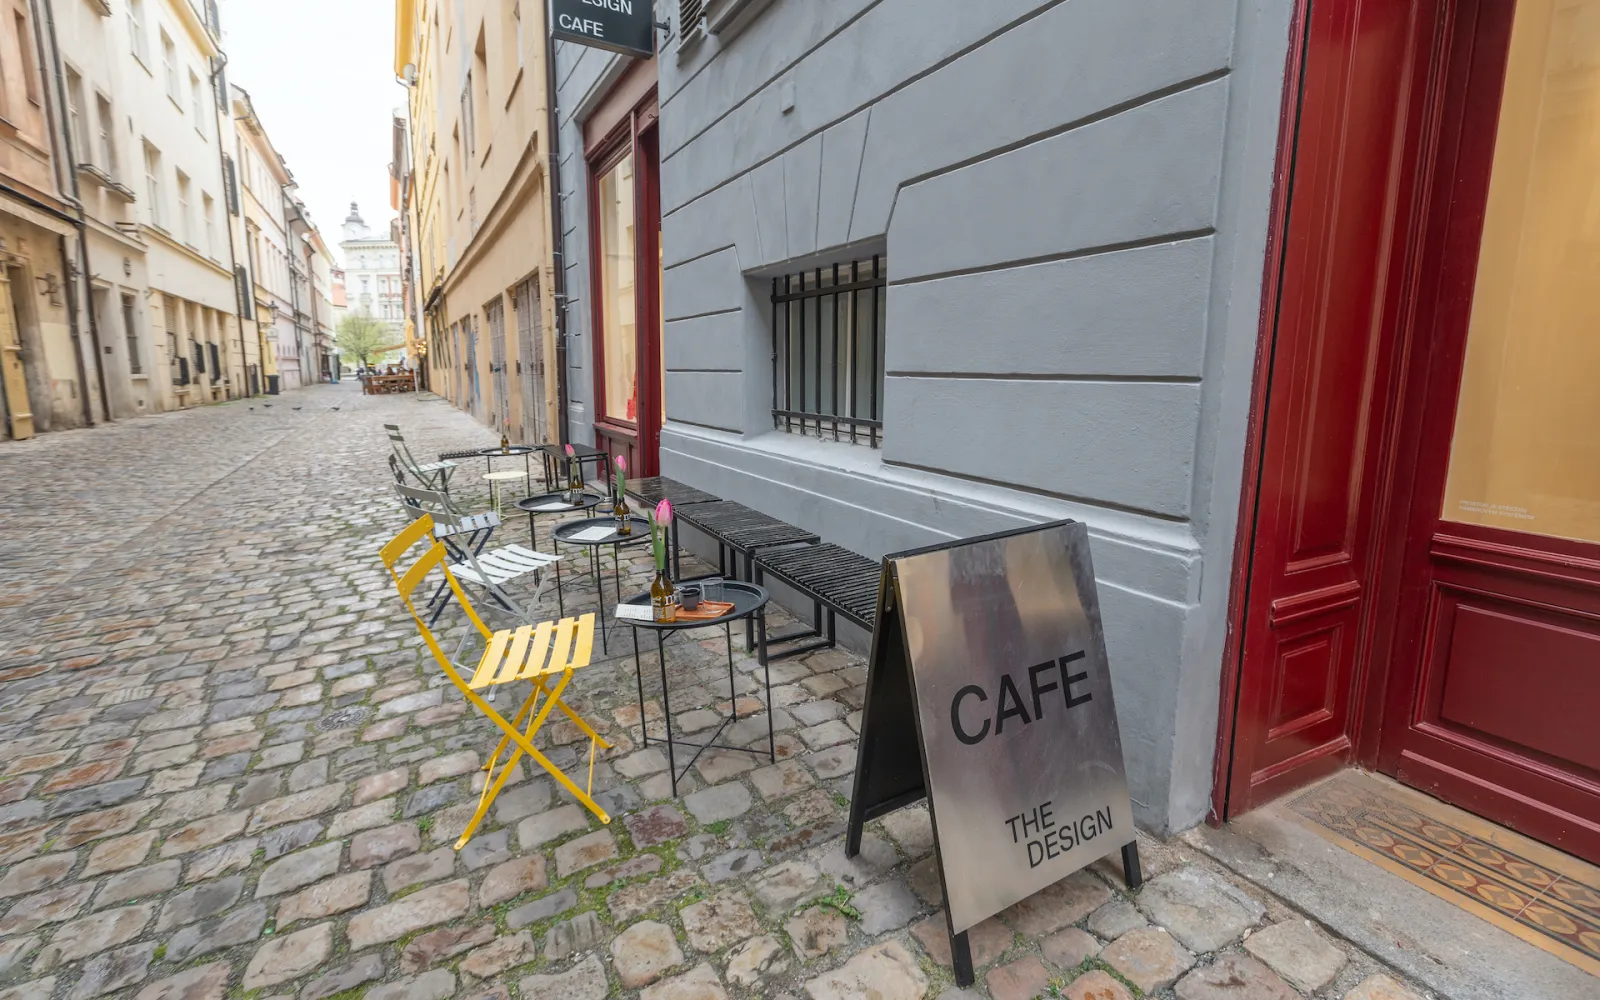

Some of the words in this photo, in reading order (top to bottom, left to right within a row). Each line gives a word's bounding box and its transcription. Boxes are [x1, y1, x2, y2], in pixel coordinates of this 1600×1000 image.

[559, 13, 604, 38] CAFE
[951, 650, 1092, 745] CAFE
[1005, 801, 1055, 843] THE
[1027, 806, 1113, 868] DESIGN
